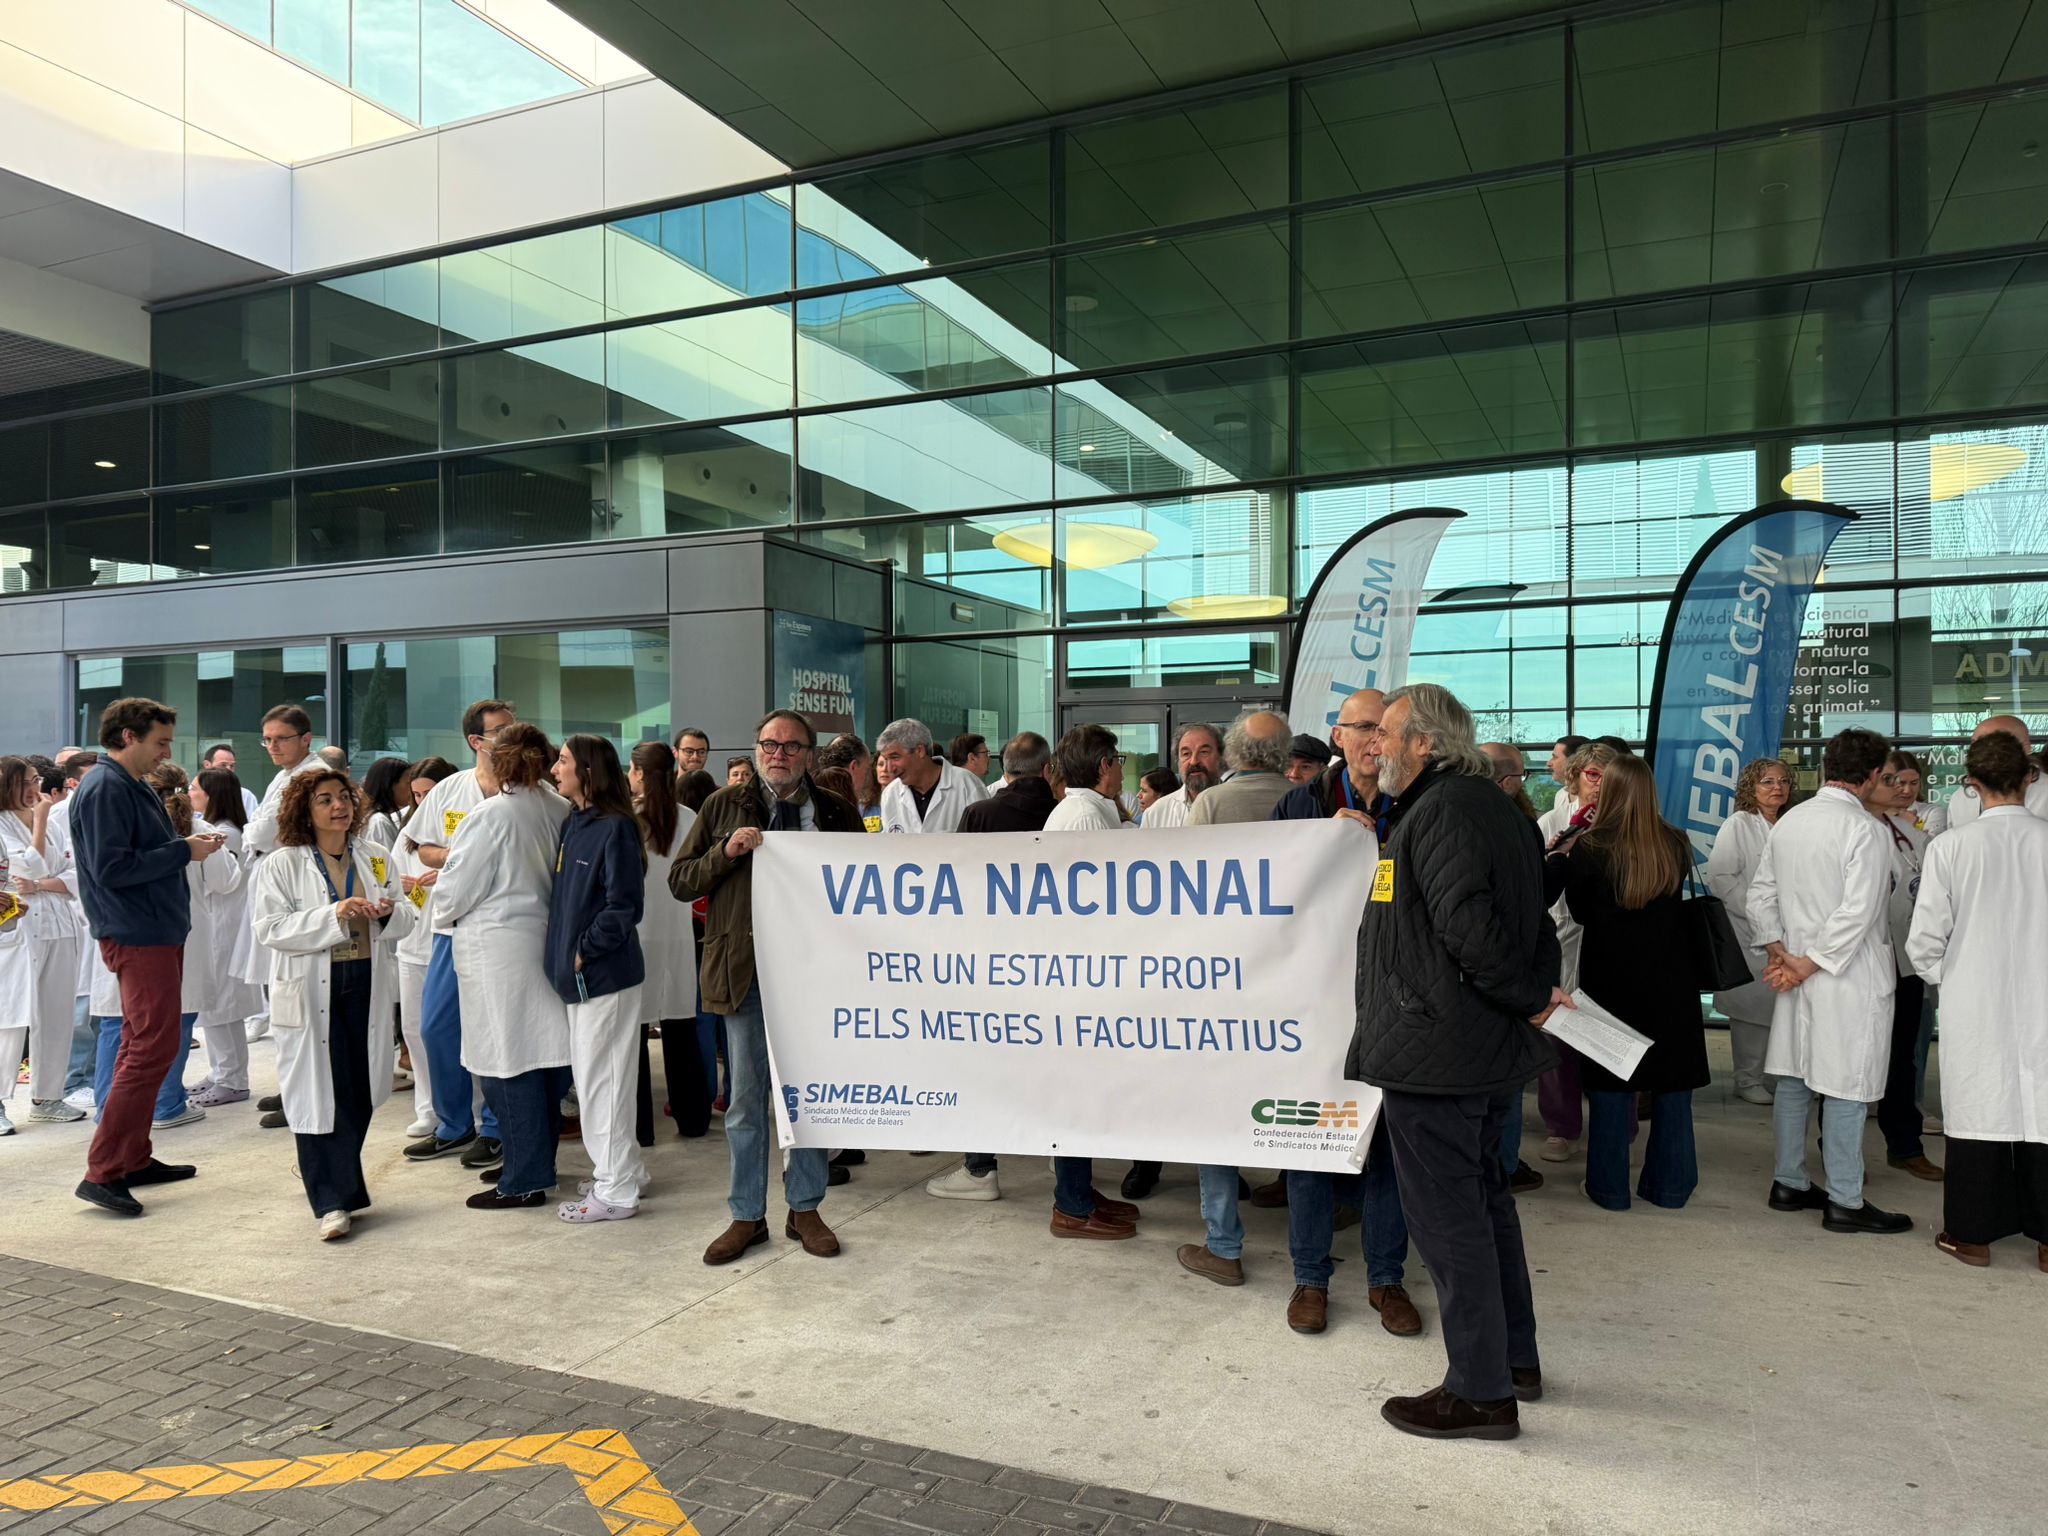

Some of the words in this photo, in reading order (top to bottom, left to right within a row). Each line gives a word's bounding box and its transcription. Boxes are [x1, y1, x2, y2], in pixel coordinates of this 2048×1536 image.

[1350, 557, 1397, 662] CESM
[1729, 543, 1784, 656] CESM
[1619, 629, 1640, 646] de
[1806, 622, 1869, 640] natural
[1811, 644, 1869, 658] natura
[792, 668, 852, 694] HOSPITAL
[1687, 686, 1706, 697] en
[1827, 678, 1869, 694] solia
[788, 692, 828, 713] SENSE
[829, 695, 855, 715] FUM
[1926, 774, 1938, 785] e
[821, 862, 964, 916] VAGA
[986, 858, 1294, 916] NACIONAL
[867, 951, 923, 983] PER
[933, 953, 976, 985] UN
[988, 953, 1128, 988] ESTATUT
[1140, 955, 1242, 990] PROPI
[834, 1007, 910, 1039] PELS
[921, 1009, 1043, 1045] METGES
[1055, 1014, 1063, 1046] I
[1075, 1015, 1302, 1053] FACULTATIUS
[804, 1083, 914, 1105] SIMEBAL
[915, 1091, 958, 1107] CESM
[804, 1106, 839, 1115] Sindicato
[839, 1106, 868, 1116] Médico
[869, 1106, 879, 1116] de
[880, 1107, 911, 1117] Baleares
[810, 1116, 840, 1125] Sindicat
[866, 1117, 876, 1125] de
[877, 1117, 904, 1126] Balears
[1251, 1098, 1358, 1128] CESM
[1253, 1128, 1323, 1140] Confederación
[1325, 1131, 1358, 1141] Estatal
[1253, 1139, 1265, 1148] de
[1268, 1140, 1318, 1150] Sindicatos
